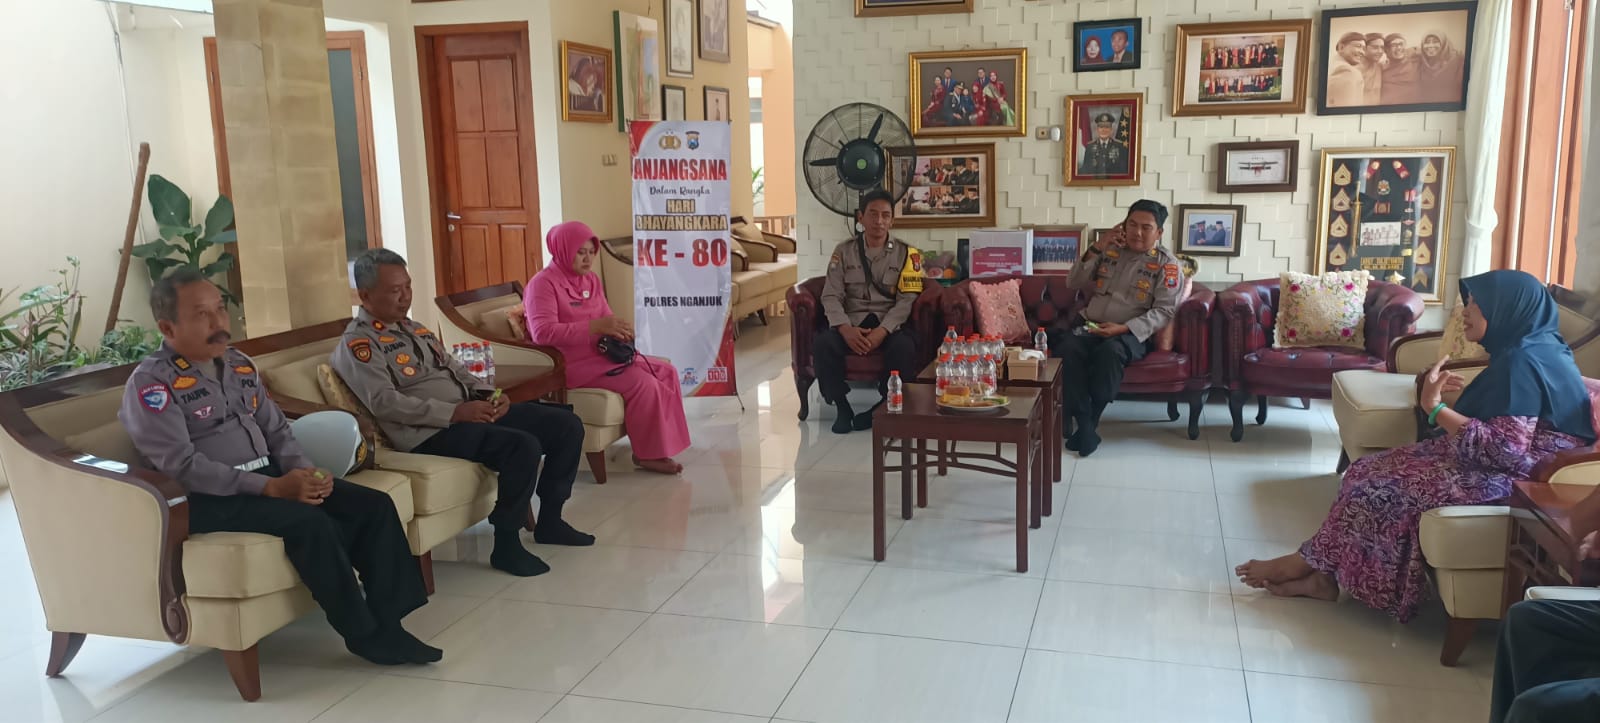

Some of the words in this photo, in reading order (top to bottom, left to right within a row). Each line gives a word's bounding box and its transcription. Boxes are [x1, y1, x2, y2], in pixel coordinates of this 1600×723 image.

[633, 158, 727, 180] ANJANGSANA
[649, 185, 677, 195] Dalam
[680, 185, 710, 197] Rangka
[666, 199, 696, 214] HARI
[635, 214, 728, 231] BHAYANGKARA
[637, 239, 668, 267] KE
[692, 238, 727, 267] 80
[644, 297, 678, 307] POLRES
[680, 296, 722, 306] NGANJUK
